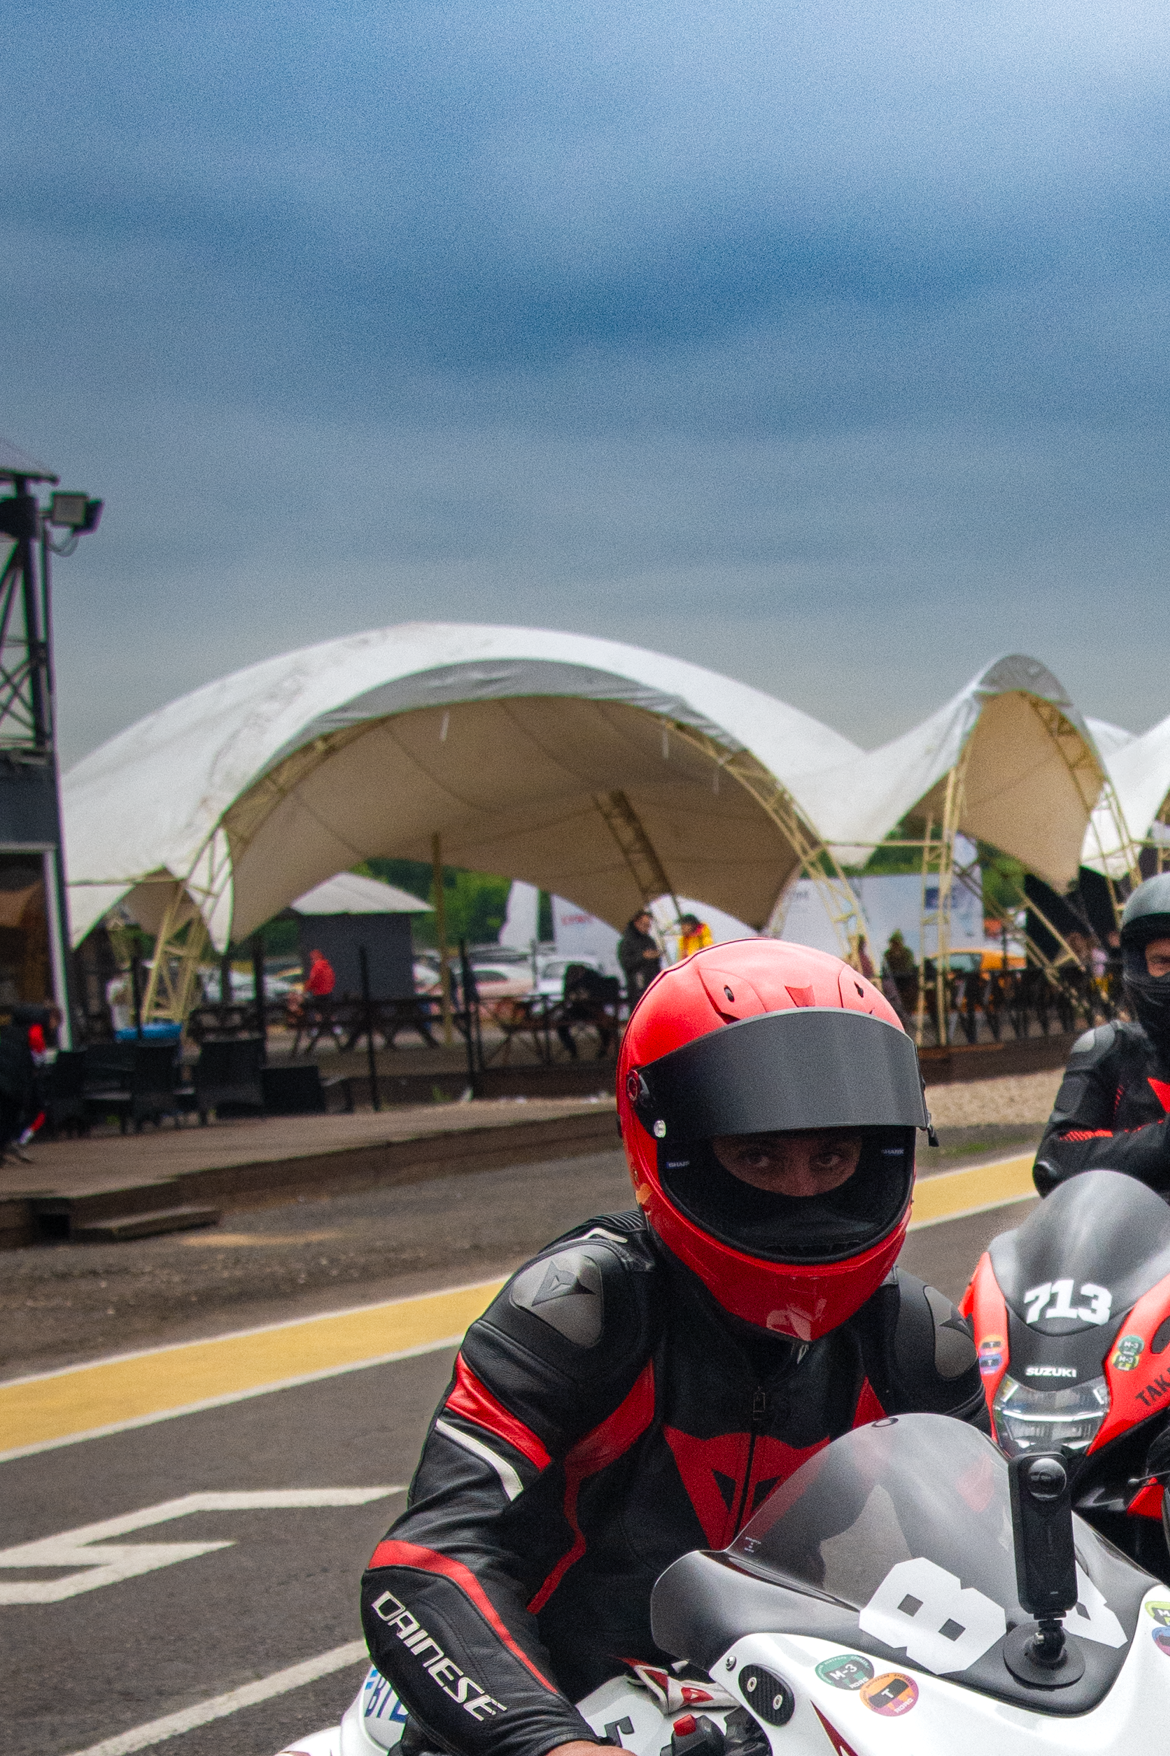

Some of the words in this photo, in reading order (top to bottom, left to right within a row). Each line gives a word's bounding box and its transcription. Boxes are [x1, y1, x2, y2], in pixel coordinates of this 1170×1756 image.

[1024, 1279, 1113, 1326] 713
[1025, 1366, 1077, 1378] SUZUKI
[371, 1590, 507, 1722] DAINESE
[829, 1663, 857, 1680] M-3
[881, 1688, 894, 1699] T
